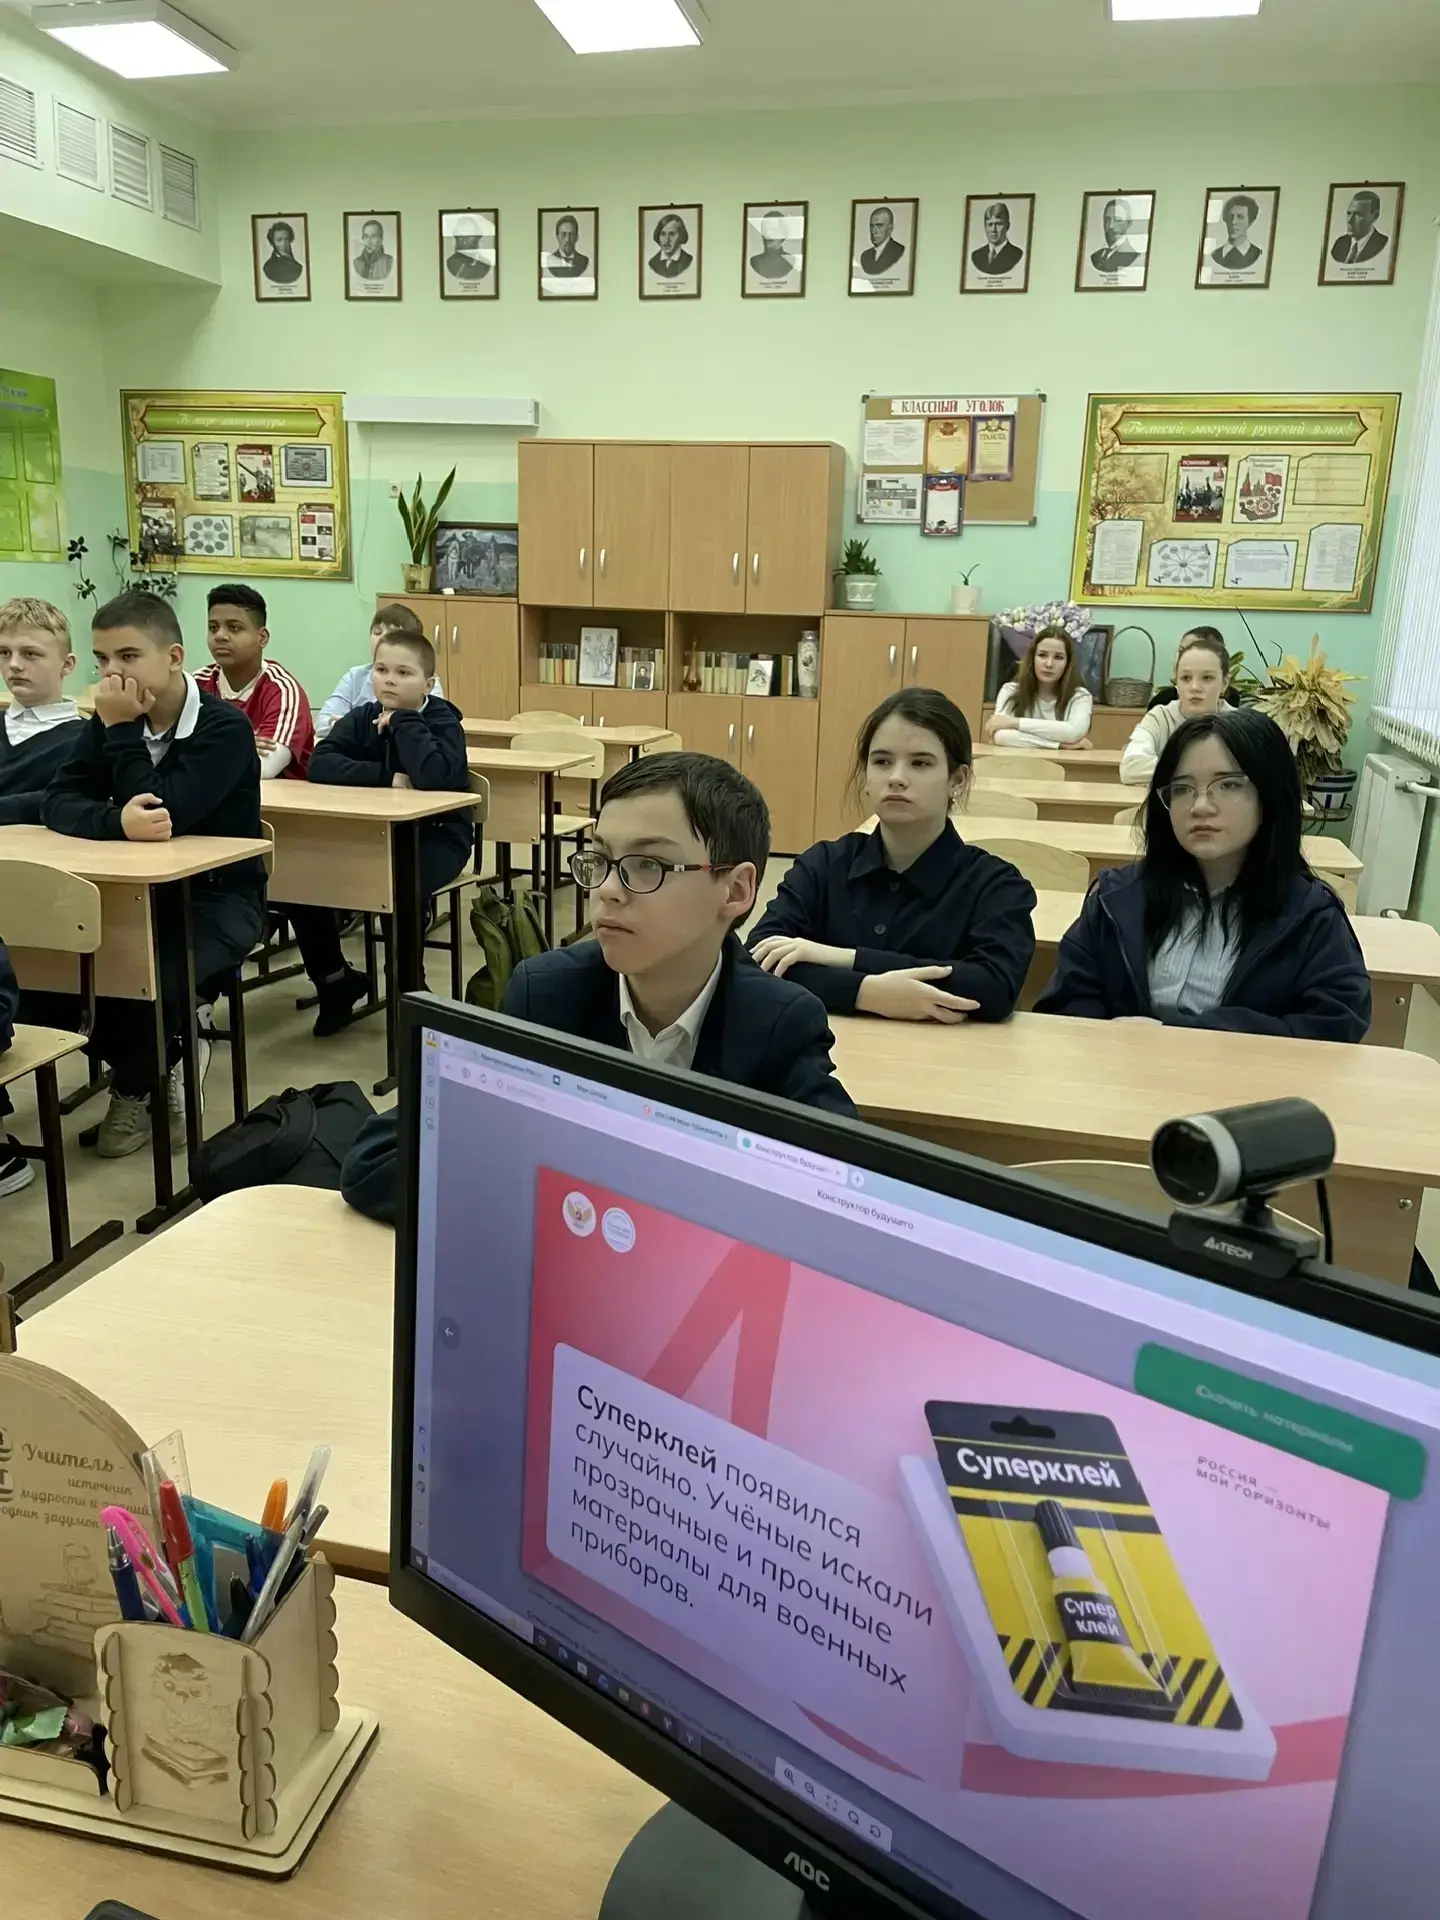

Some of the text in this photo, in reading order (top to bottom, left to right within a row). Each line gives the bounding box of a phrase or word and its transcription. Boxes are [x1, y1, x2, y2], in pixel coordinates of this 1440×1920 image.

[901, 399, 1005, 413] КЛАССНЫЙ УГОЛОК
[1251, 421, 1306, 438] русский
[817, 1189, 914, 1230] Конструктор будущего
[22, 1442, 114, 1473] Учитель
[577, 1384, 862, 1548] Суперклей появился
[957, 1447, 1121, 1489] Суперклей
[1197, 1455, 1258, 1488] РОССИЯ
[20, 1489, 86, 1506] мудрости
[90, 1498, 98, 1508] и
[68, 1477, 133, 1496] источник
[1196, 1468, 1331, 1531] МОИ ГОРИЗОНТЫ
[0, 1506, 101, 1529] одник задумок
[576, 1422, 933, 1627] случайно. Учёные искали
[571, 1520, 694, 1608] приборов.
[574, 1455, 893, 1644] прозрачные и прочные
[572, 1488, 711, 1581] материалы
[718, 1572, 767, 1613] для
[777, 1603, 907, 1693] военных
[1064, 1597, 1117, 1618] Супер
[1075, 1617, 1120, 1637] клей
[784, 1851, 831, 1892] AOC
